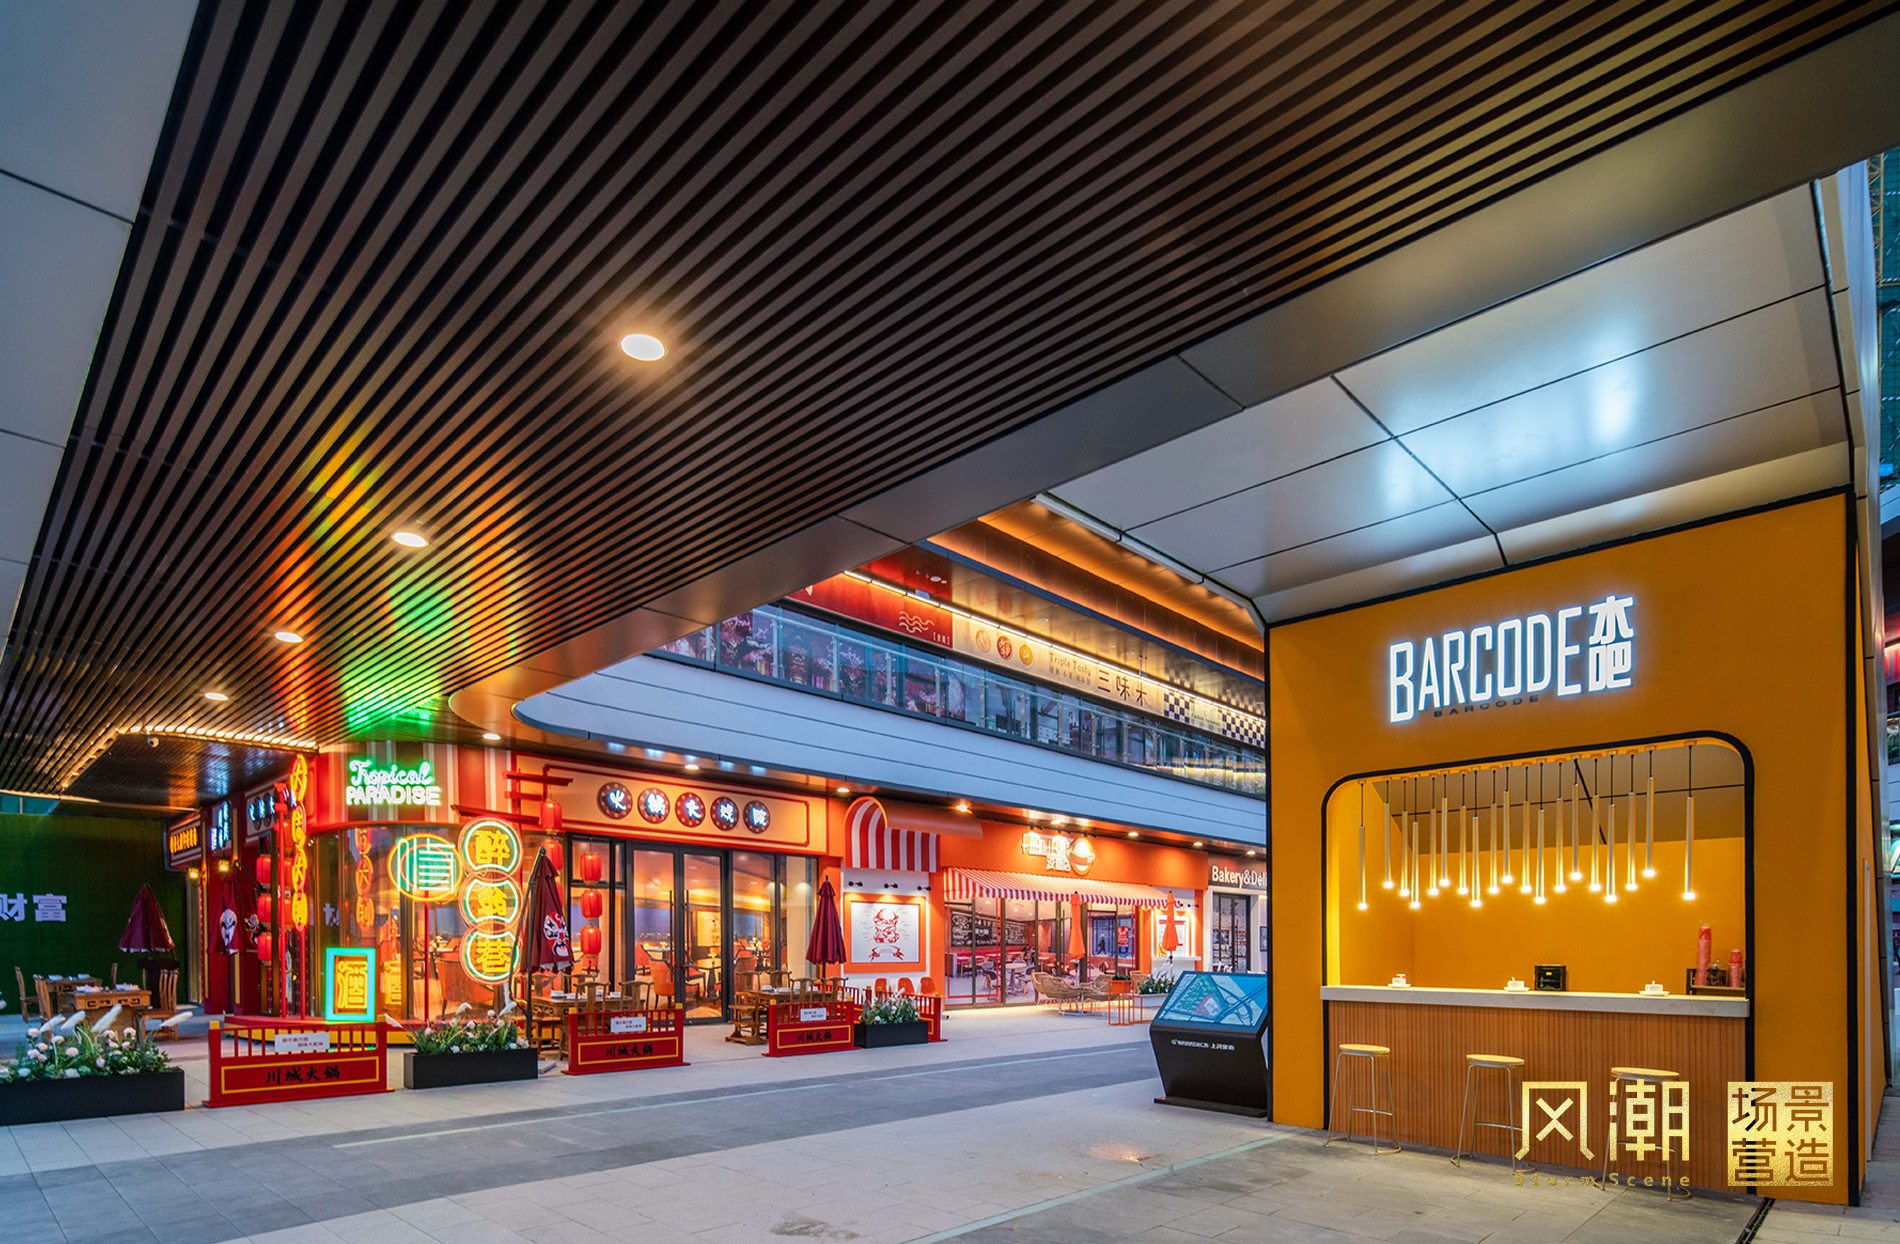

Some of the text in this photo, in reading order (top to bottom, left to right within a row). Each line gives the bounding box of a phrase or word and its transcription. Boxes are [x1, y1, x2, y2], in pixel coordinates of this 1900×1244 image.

[1049, 651, 1071, 668] Triple
[1388, 605, 1583, 723] BARCODE
[1433, 694, 1539, 718] BARCODE
[348, 759, 434, 790] Tropical
[345, 785, 442, 806] PARADISE
[0, 892, 68, 923] 财富
[474, 829, 512, 974] 醉翁巷
